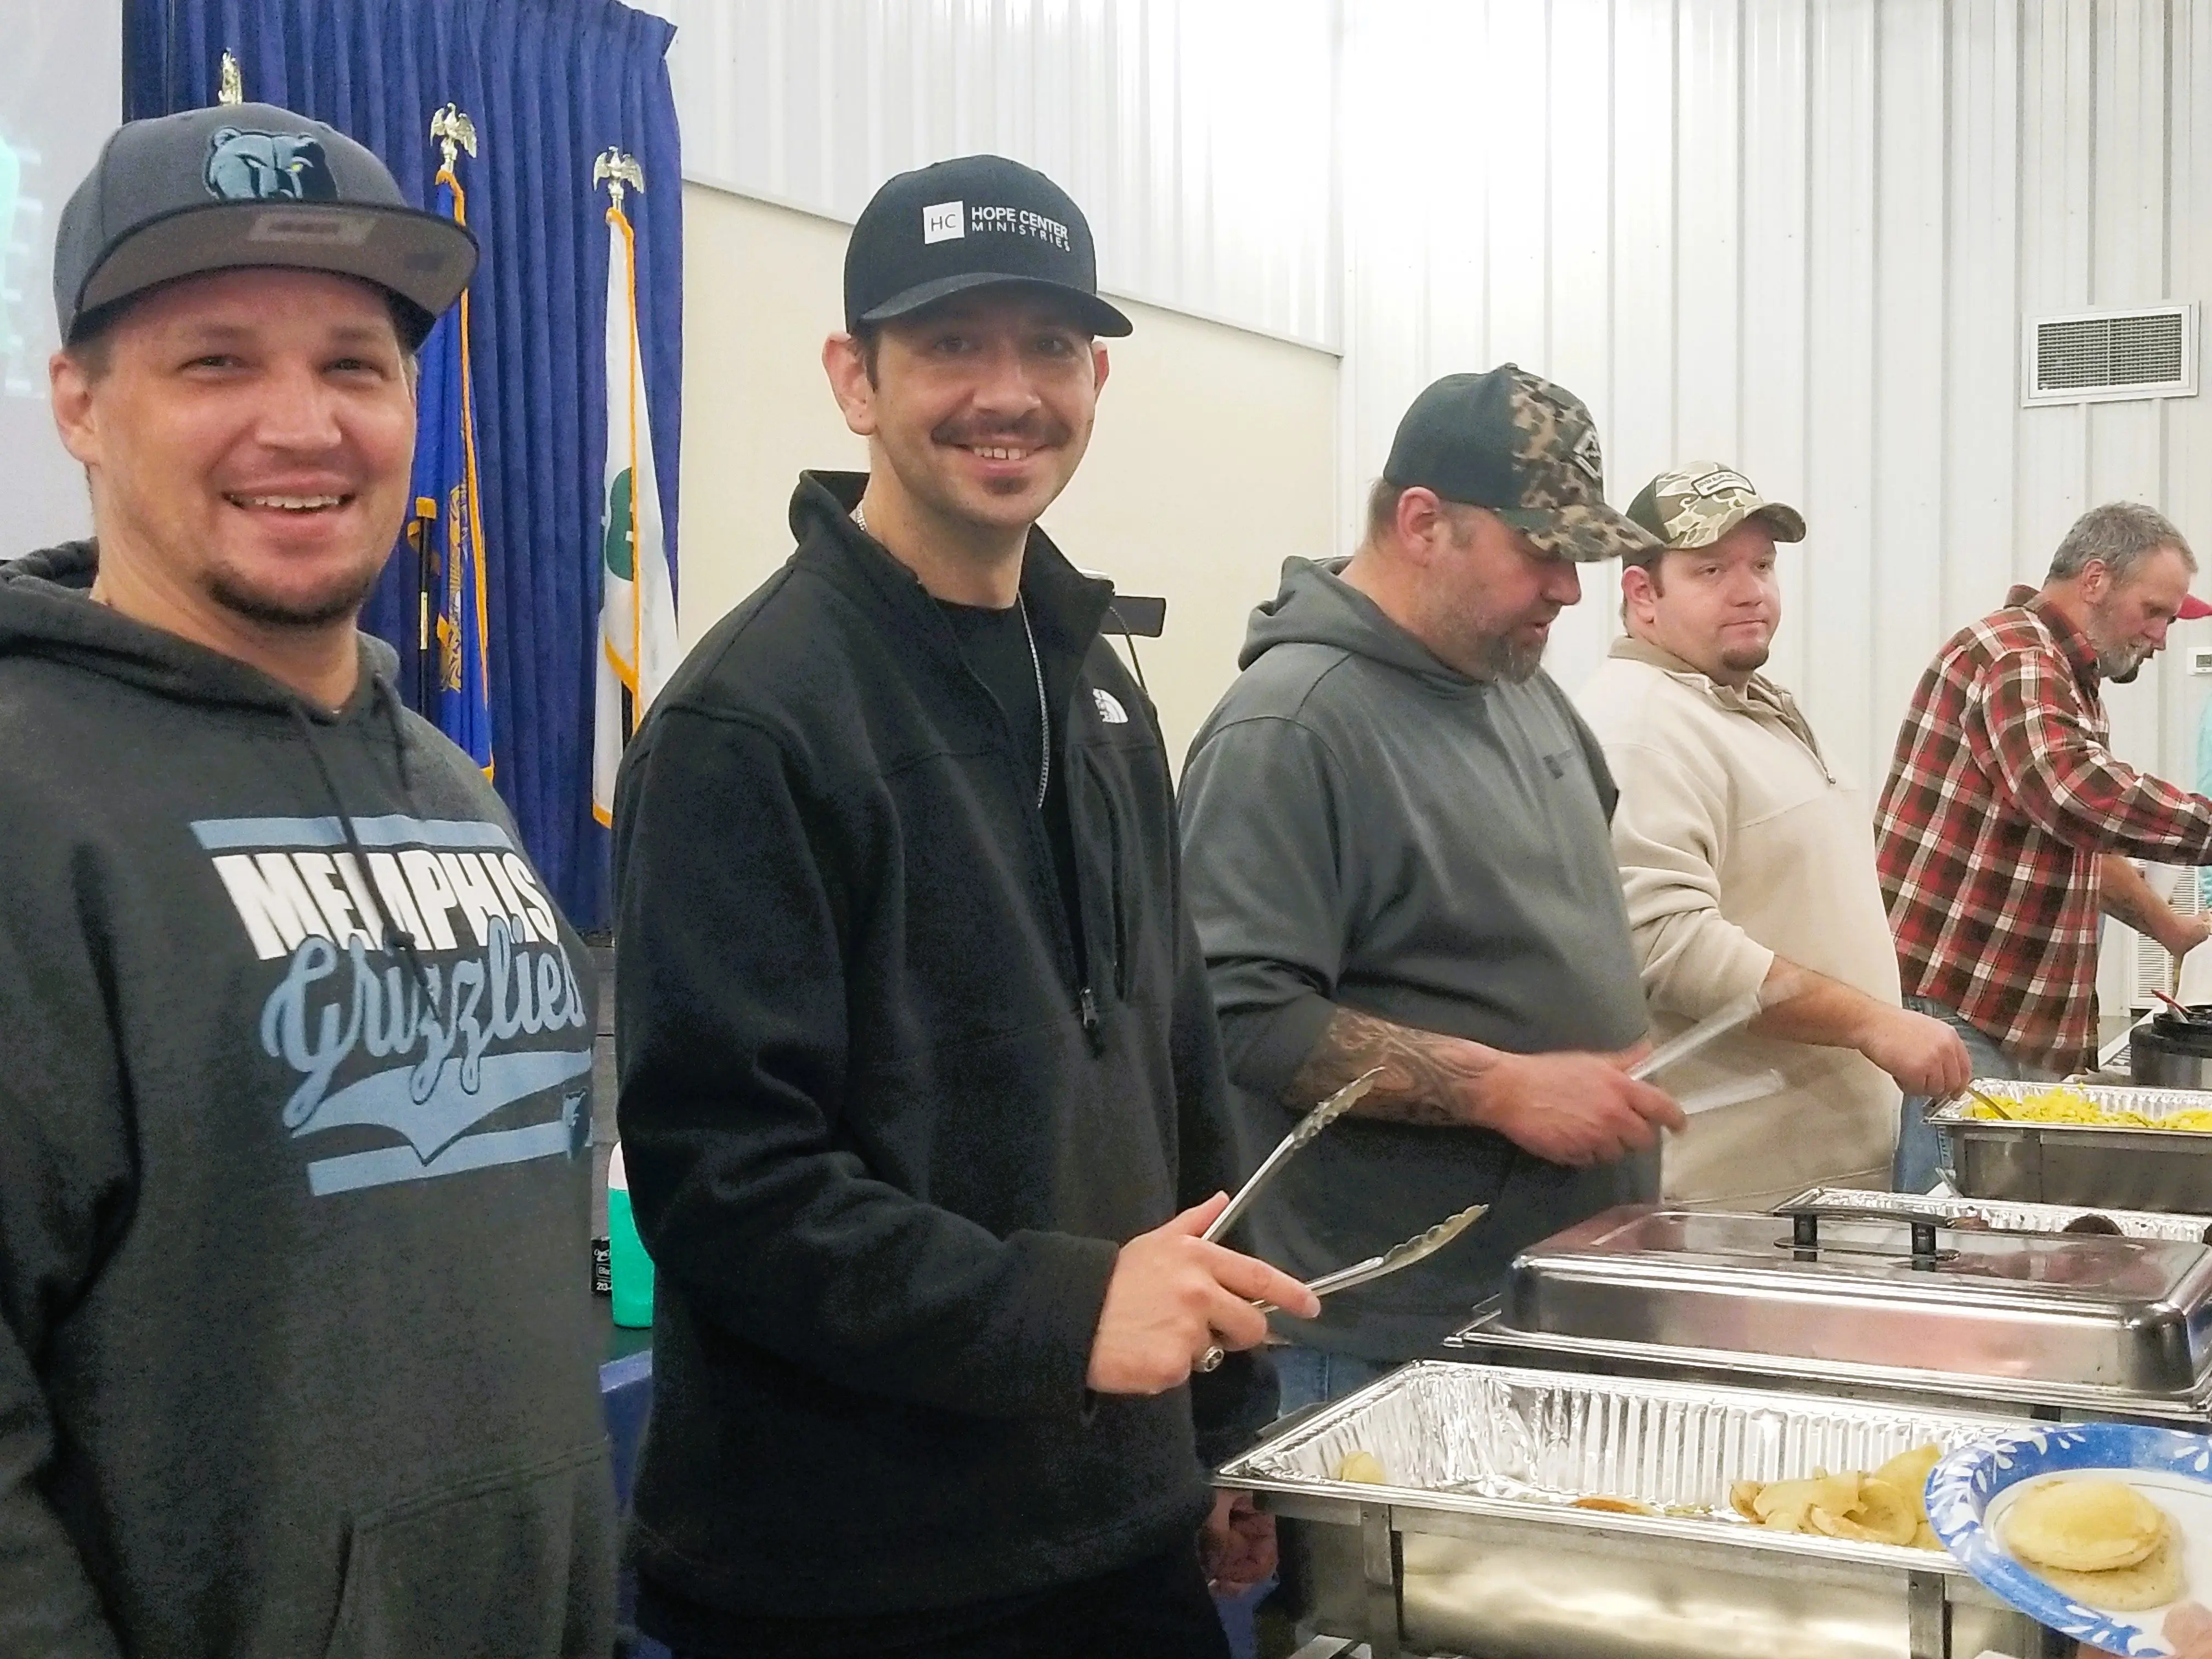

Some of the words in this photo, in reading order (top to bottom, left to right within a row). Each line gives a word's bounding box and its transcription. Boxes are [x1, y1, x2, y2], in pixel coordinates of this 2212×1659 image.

[931, 213, 956, 232] HC
[972, 207, 1017, 222] HOPE
[1019, 210, 1069, 240] CENTER
[972, 222, 1070, 252] MINISTRIES
[211, 849, 558, 960] MEMPHIS
